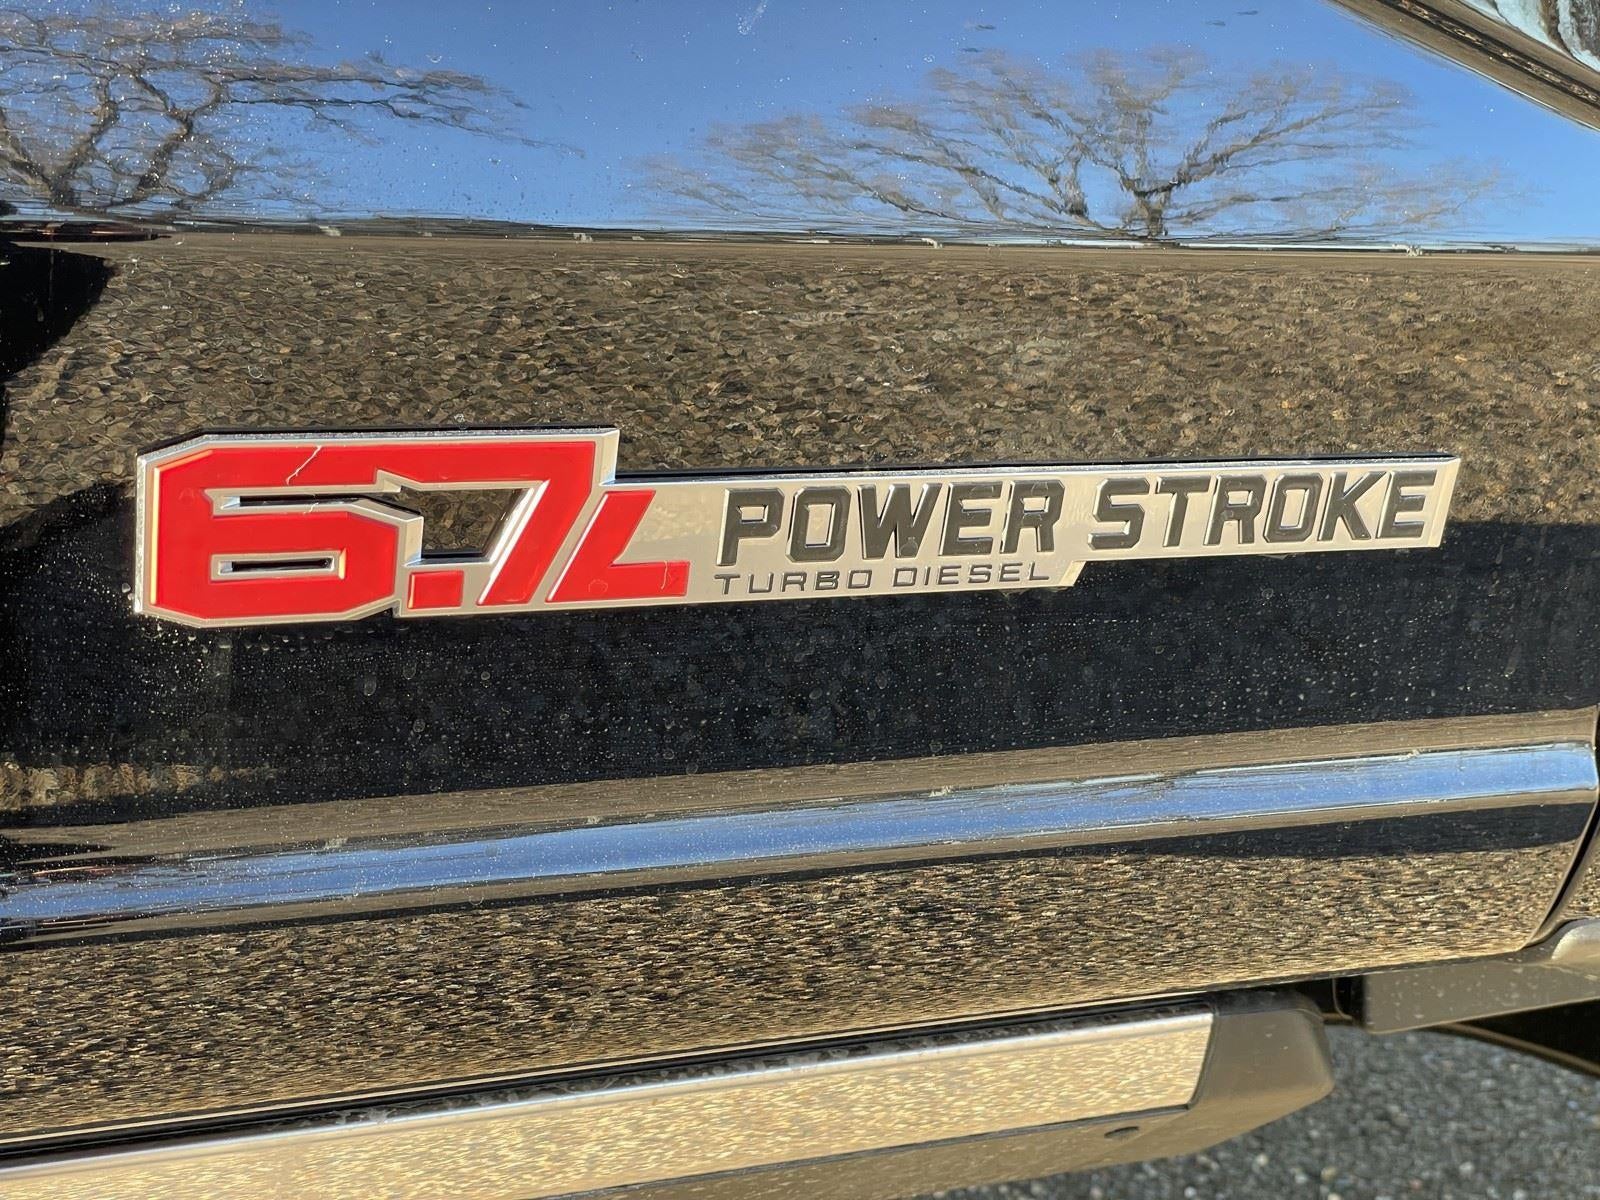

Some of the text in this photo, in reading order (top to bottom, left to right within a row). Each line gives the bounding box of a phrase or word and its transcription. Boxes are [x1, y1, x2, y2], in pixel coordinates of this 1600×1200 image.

[150, 440, 1438, 620] 6.7L POWER STROKE
[714, 562, 1051, 595] TURBO DIESEL
